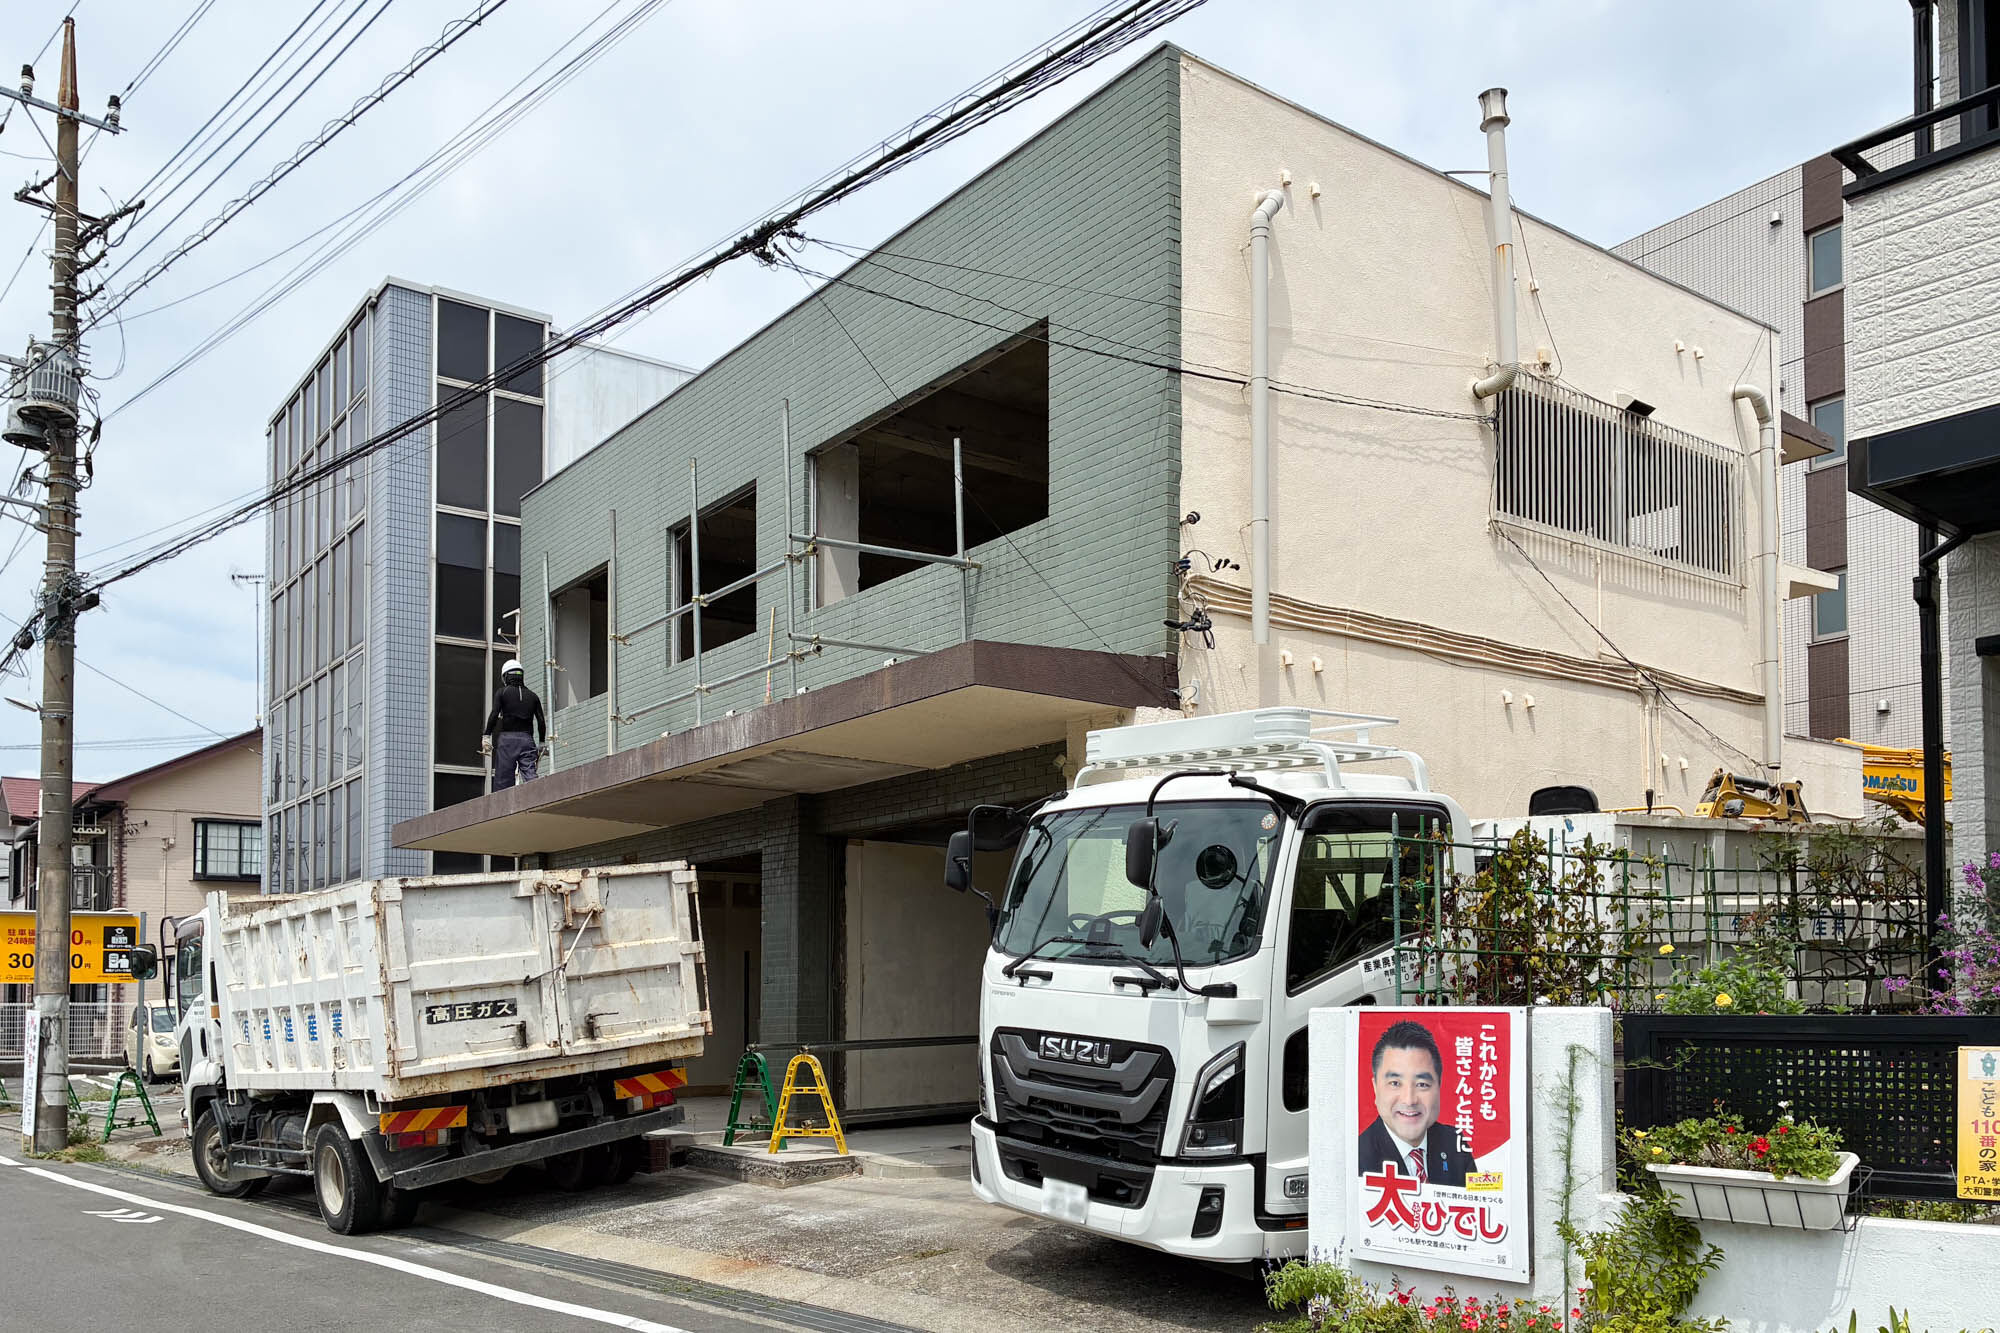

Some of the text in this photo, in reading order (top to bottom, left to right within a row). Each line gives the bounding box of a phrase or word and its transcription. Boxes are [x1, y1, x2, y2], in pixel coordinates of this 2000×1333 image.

[431, 1002, 513, 1023] 高圧ガス
[1039, 1035, 1111, 1065] ISUZU
[1479, 1024, 1498, 1121] これからも
[1455, 1036, 1474, 1153] 皆さんと共に
